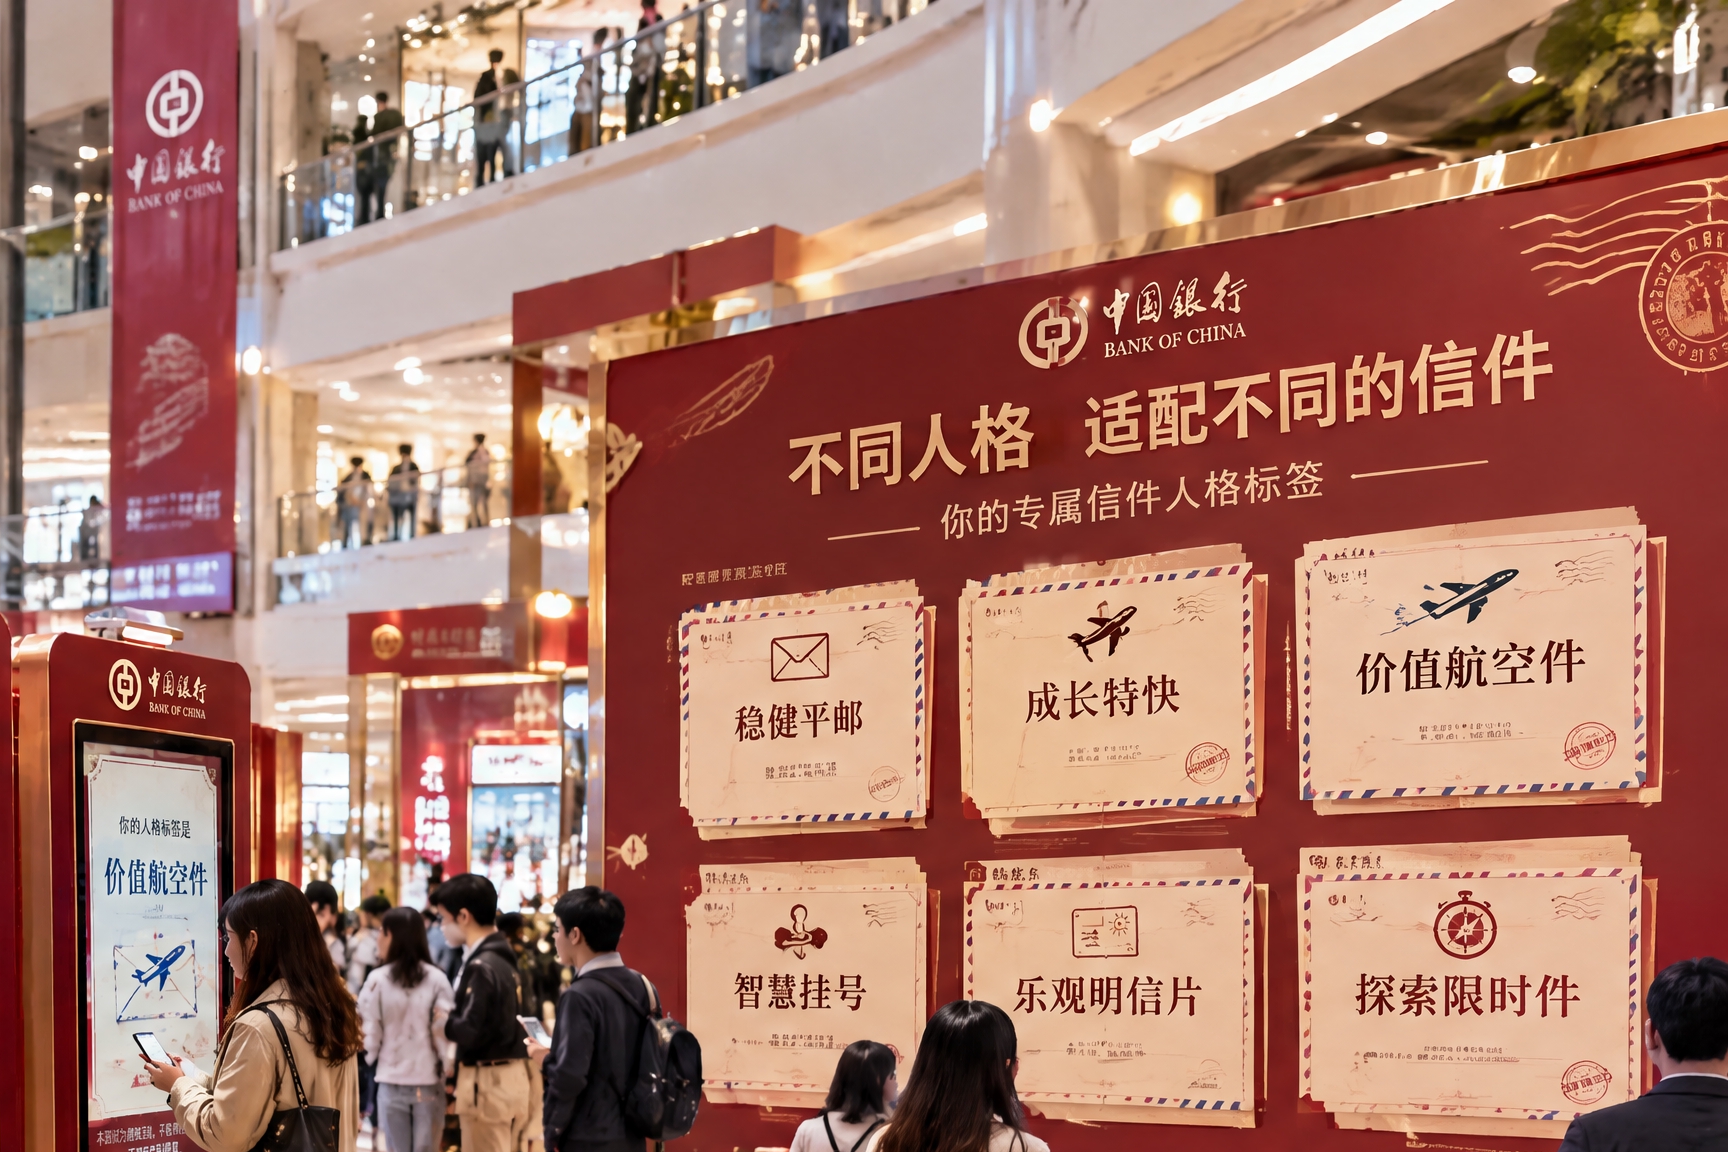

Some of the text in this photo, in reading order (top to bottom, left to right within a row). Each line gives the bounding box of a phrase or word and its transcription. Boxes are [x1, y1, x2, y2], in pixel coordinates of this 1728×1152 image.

[127, 180, 224, 213] BANK OF CHINA
[1104, 322, 1246, 358] BANK OF CHINA
[788, 330, 1554, 496] 不同人格 适配不同的信件
[941, 461, 1324, 540] 你的专属信件人格标签
[1355, 639, 1586, 696] 价值航空件
[149, 701, 206, 719] BANK OF CHINA
[1025, 674, 1181, 724] 成长特快
[734, 699, 863, 742] 稳健平邮
[119, 815, 191, 840] 你的人格标签是
[104, 856, 209, 898] 价值航空件
[733, 972, 867, 1012] 智慧挂号
[1013, 975, 1202, 1017] 乐观明信片
[1354, 972, 1581, 1018] 探索限时件
